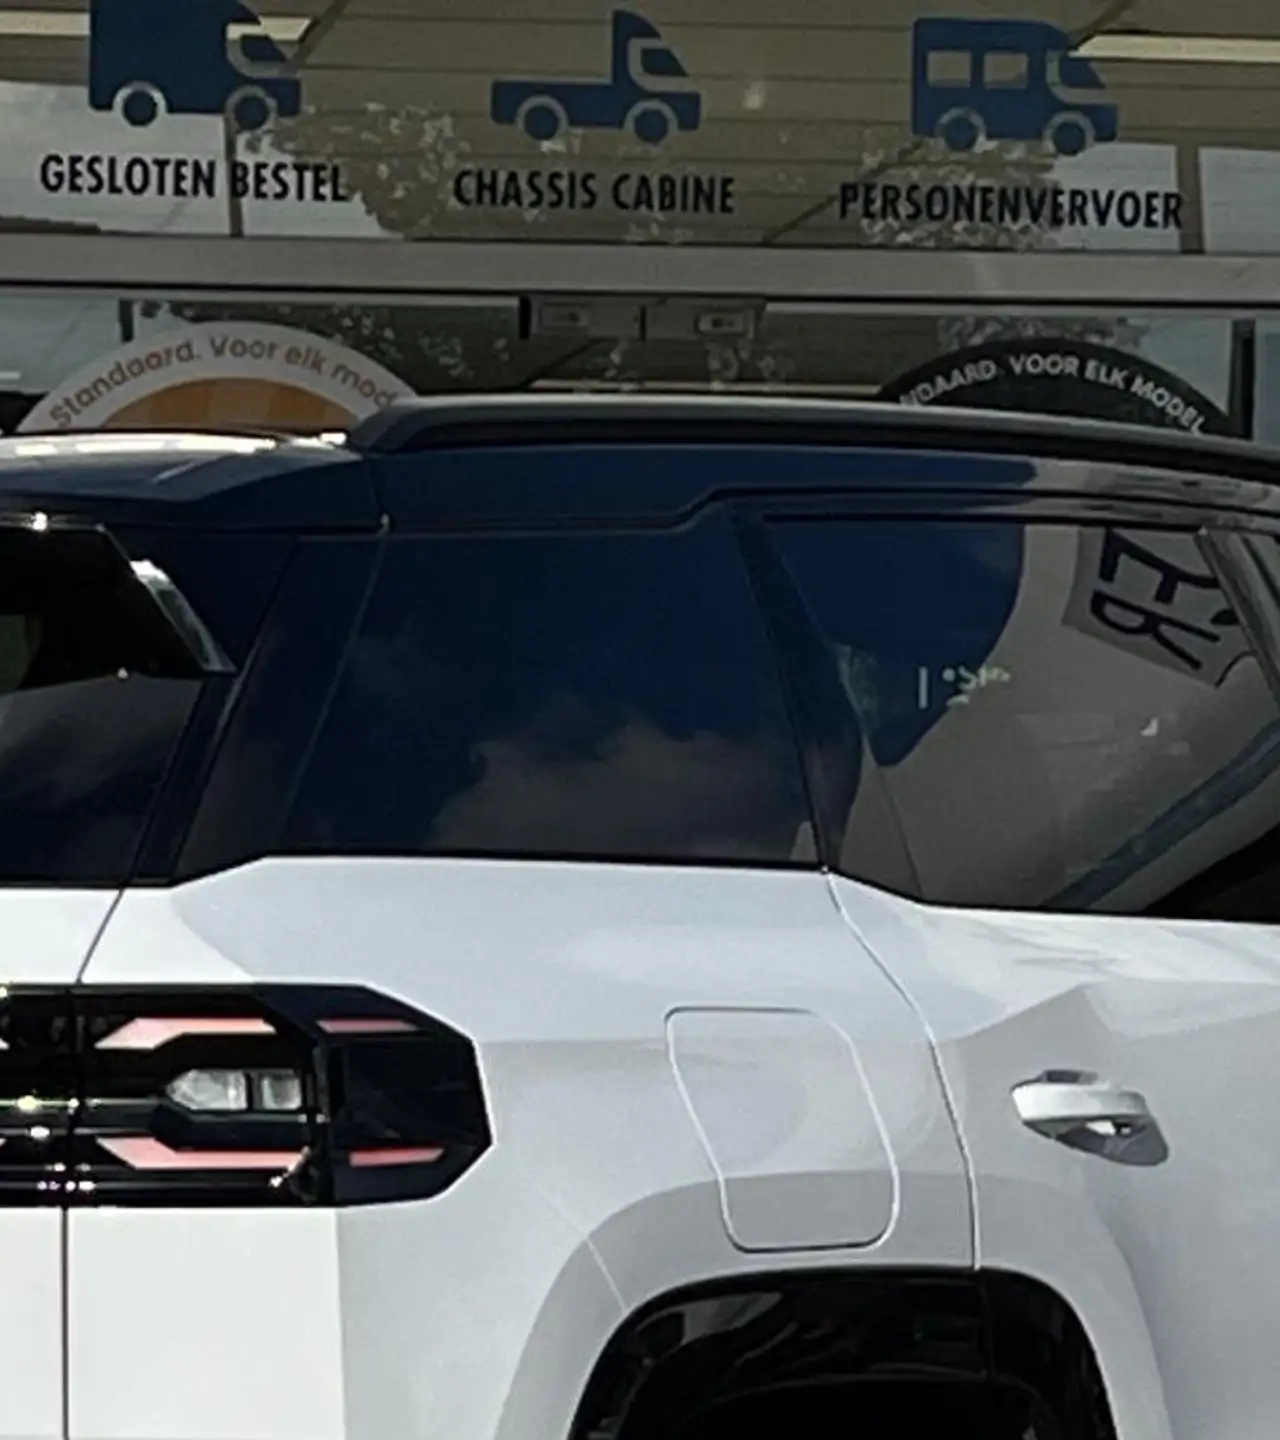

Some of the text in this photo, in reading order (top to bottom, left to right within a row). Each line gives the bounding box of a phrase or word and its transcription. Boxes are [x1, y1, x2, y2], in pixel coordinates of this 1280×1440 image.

[39, 154, 354, 203] GESLOTEN BESTEL
[452, 168, 735, 214] CHASSIS CABINE
[838, 182, 1184, 230] PERSONENVERVOER
[210, 335, 278, 361] Voor
[284, 344, 328, 378] elk
[1009, 353, 1079, 379] VOOR
[1083, 358, 1131, 392] ELK
[1130, 374, 1208, 437] MODEL
